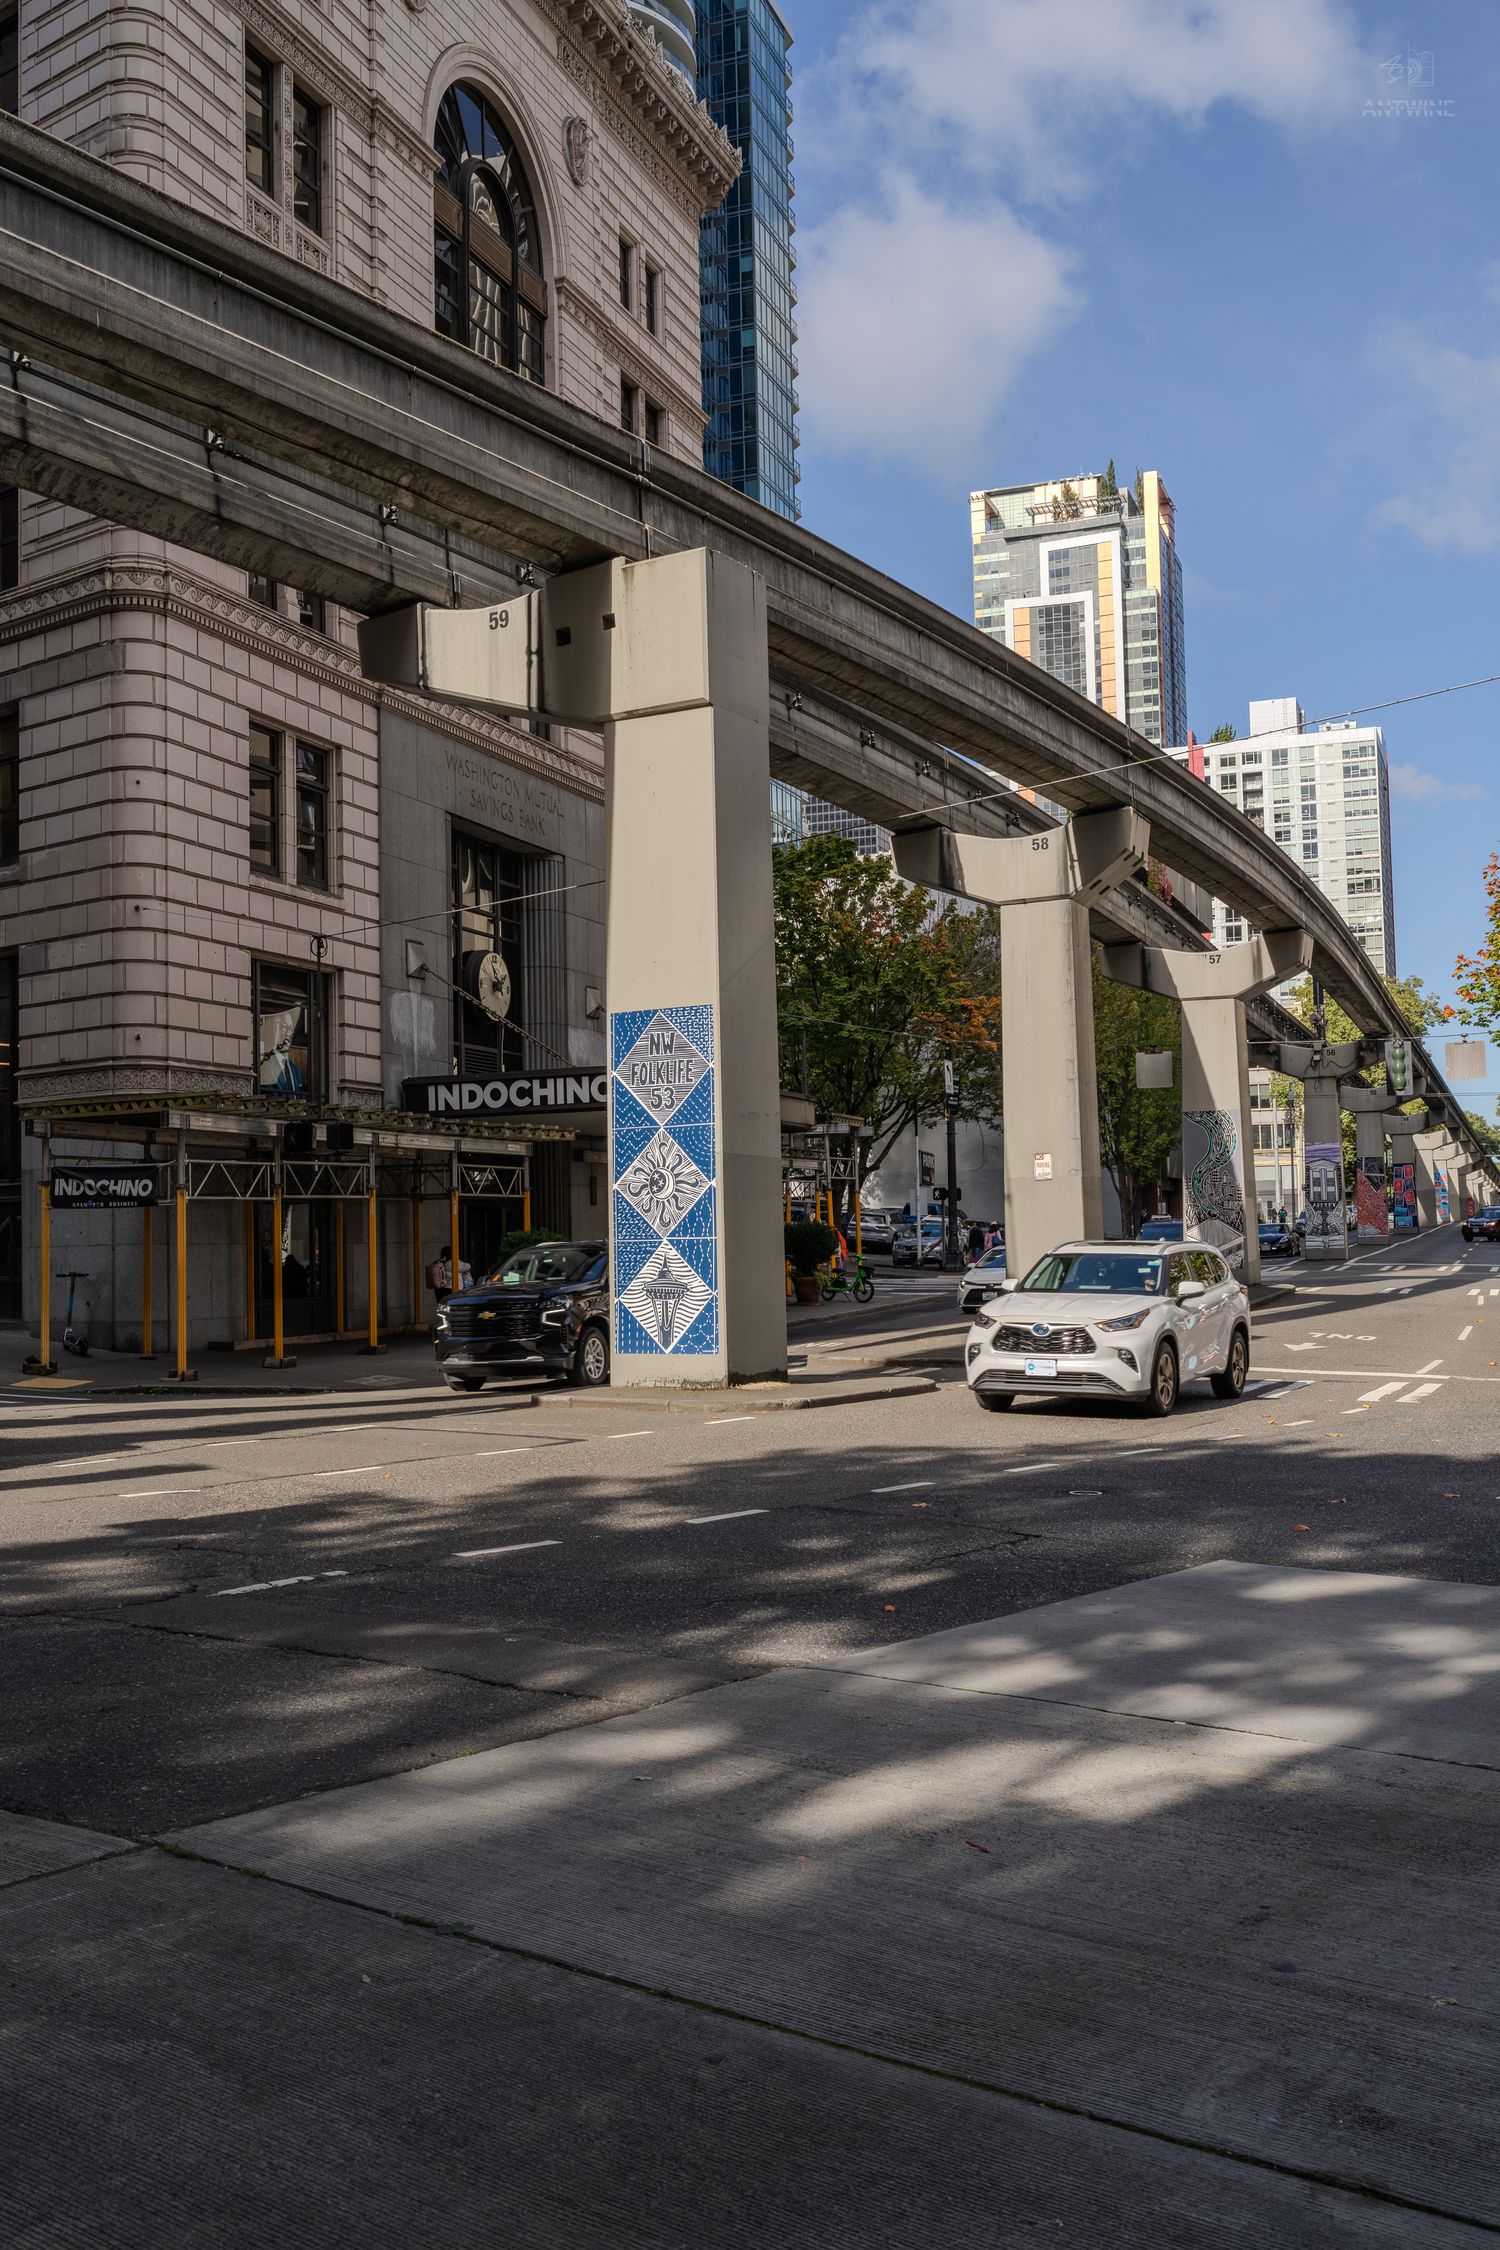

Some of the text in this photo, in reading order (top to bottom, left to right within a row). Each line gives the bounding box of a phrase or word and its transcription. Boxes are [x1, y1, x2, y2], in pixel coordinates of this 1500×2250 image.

[489, 609, 509, 630] 59
[444, 750, 565, 818] WASHINGTON MUTUAL
[470, 789, 546, 837] SAVINGS BANK
[1031, 837, 1049, 851] 58
[1209, 954, 1222, 965] 57
[649, 1032, 676, 1056] NW
[630, 1059, 694, 1087] FOLKLIFE
[650, 1086, 676, 1110] 53
[54, 1178, 153, 1197] INDOCHINO
